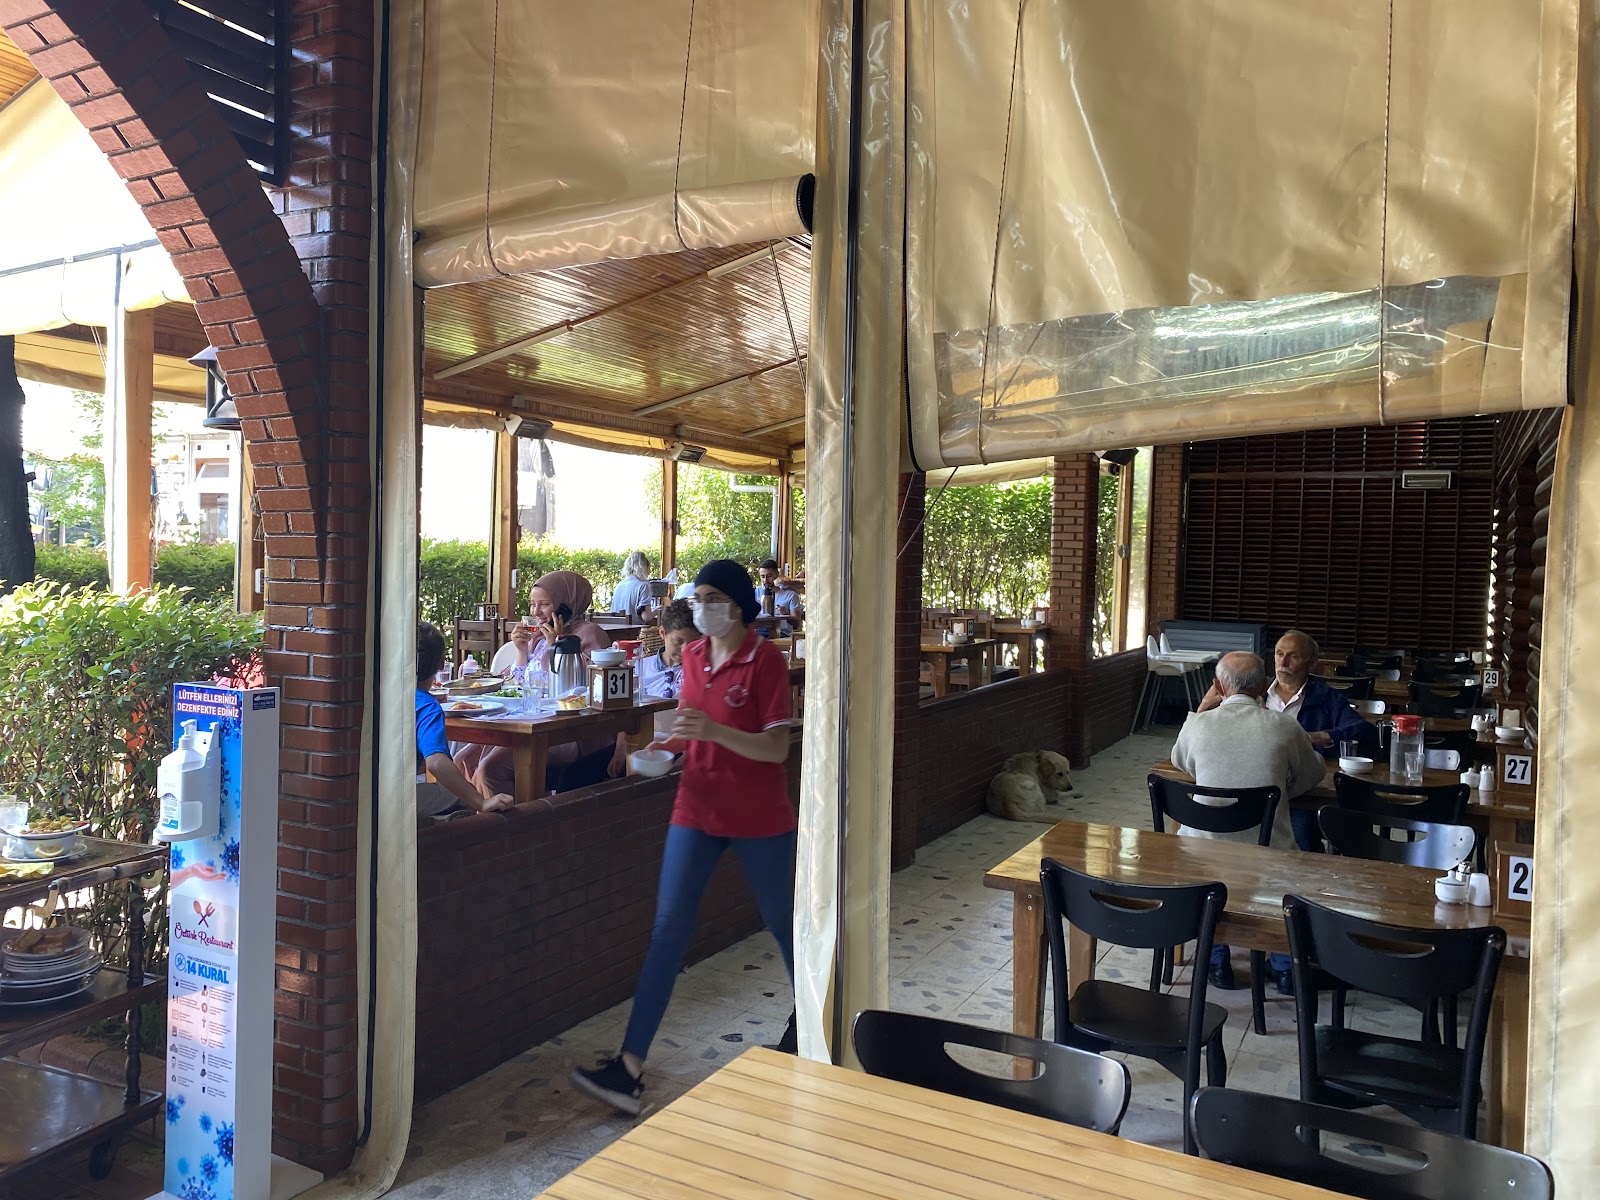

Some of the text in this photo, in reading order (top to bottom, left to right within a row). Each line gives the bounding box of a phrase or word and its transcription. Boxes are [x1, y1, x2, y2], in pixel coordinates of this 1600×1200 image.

[610, 672, 626, 695] 31
[1485, 672, 1497, 685] 29
[178, 689, 202, 702] LÜTFEN
[203, 692, 238, 706] ELLERİNİZİ
[177, 702, 240, 718] DEZENFEKTE EDİNİZ
[1507, 758, 1529, 780] 27
[1512, 862, 1533, 895] 2
[198, 931, 234, 950] Restaurant
[187, 960, 197, 975] 14
[198, 963, 230, 985] KURAL
